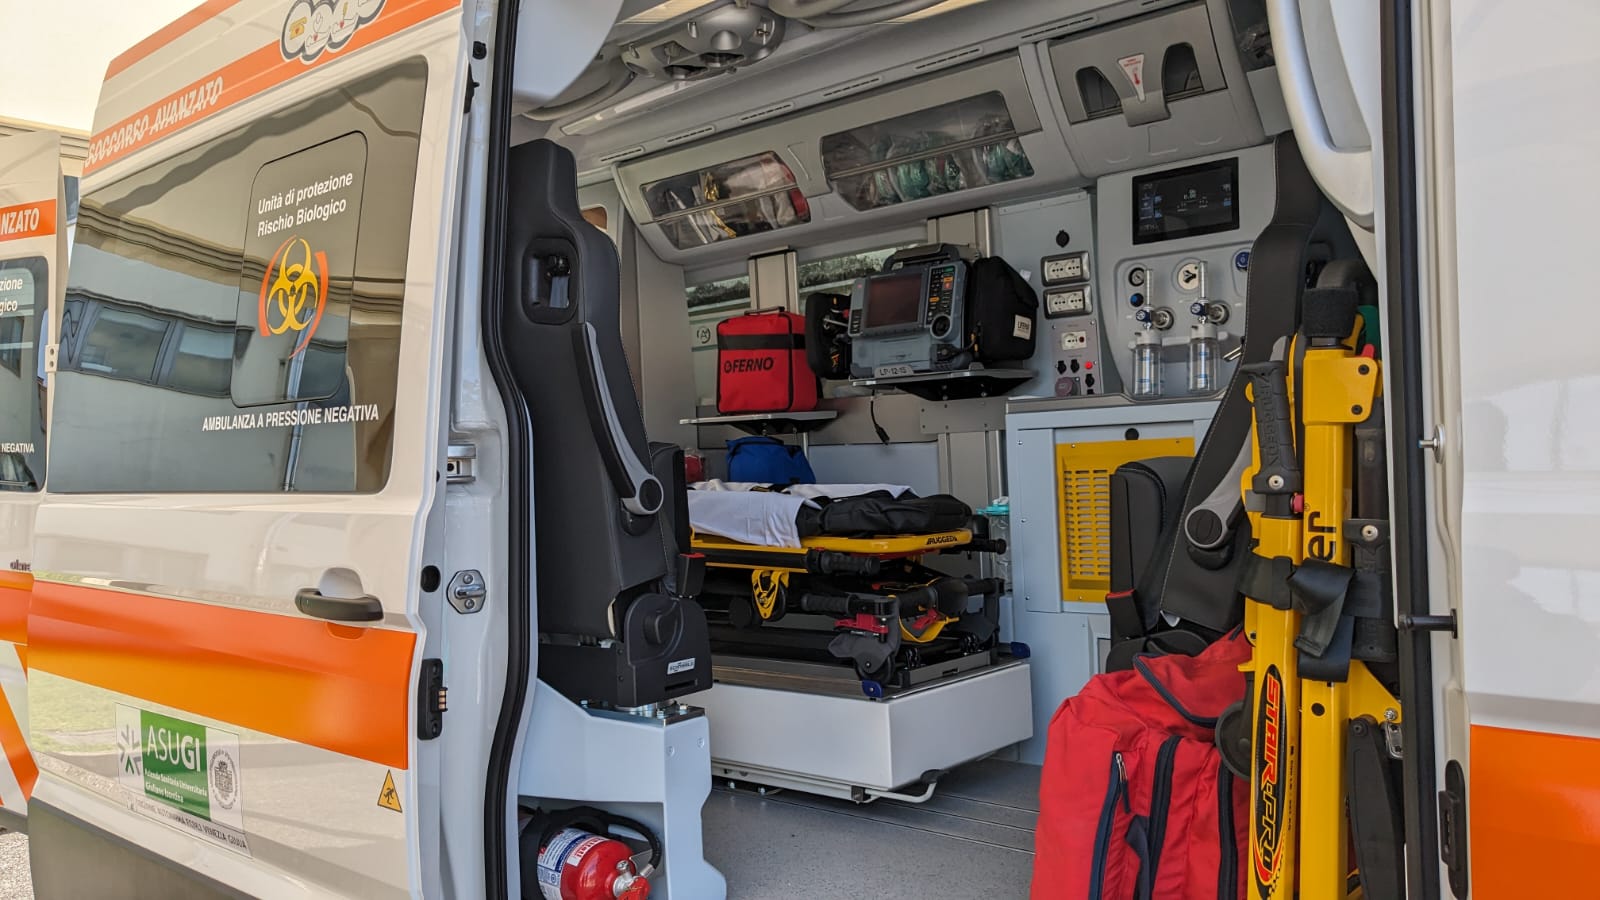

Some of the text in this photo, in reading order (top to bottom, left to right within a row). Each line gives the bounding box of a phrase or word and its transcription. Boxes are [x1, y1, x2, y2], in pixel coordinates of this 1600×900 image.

[84, 76, 223, 168] SOCCORSO AVANZATO
[258, 172, 353, 214] Unità di protezione
[257, 198, 346, 237] Rischio Biologico
[732, 356, 775, 373] FERNO
[202, 404, 379, 431] AMBULANZA A PRESSIONE NEGATIVA
[1, 442, 35, 454] NEGATIVA
[147, 725, 200, 772] ASUGI
